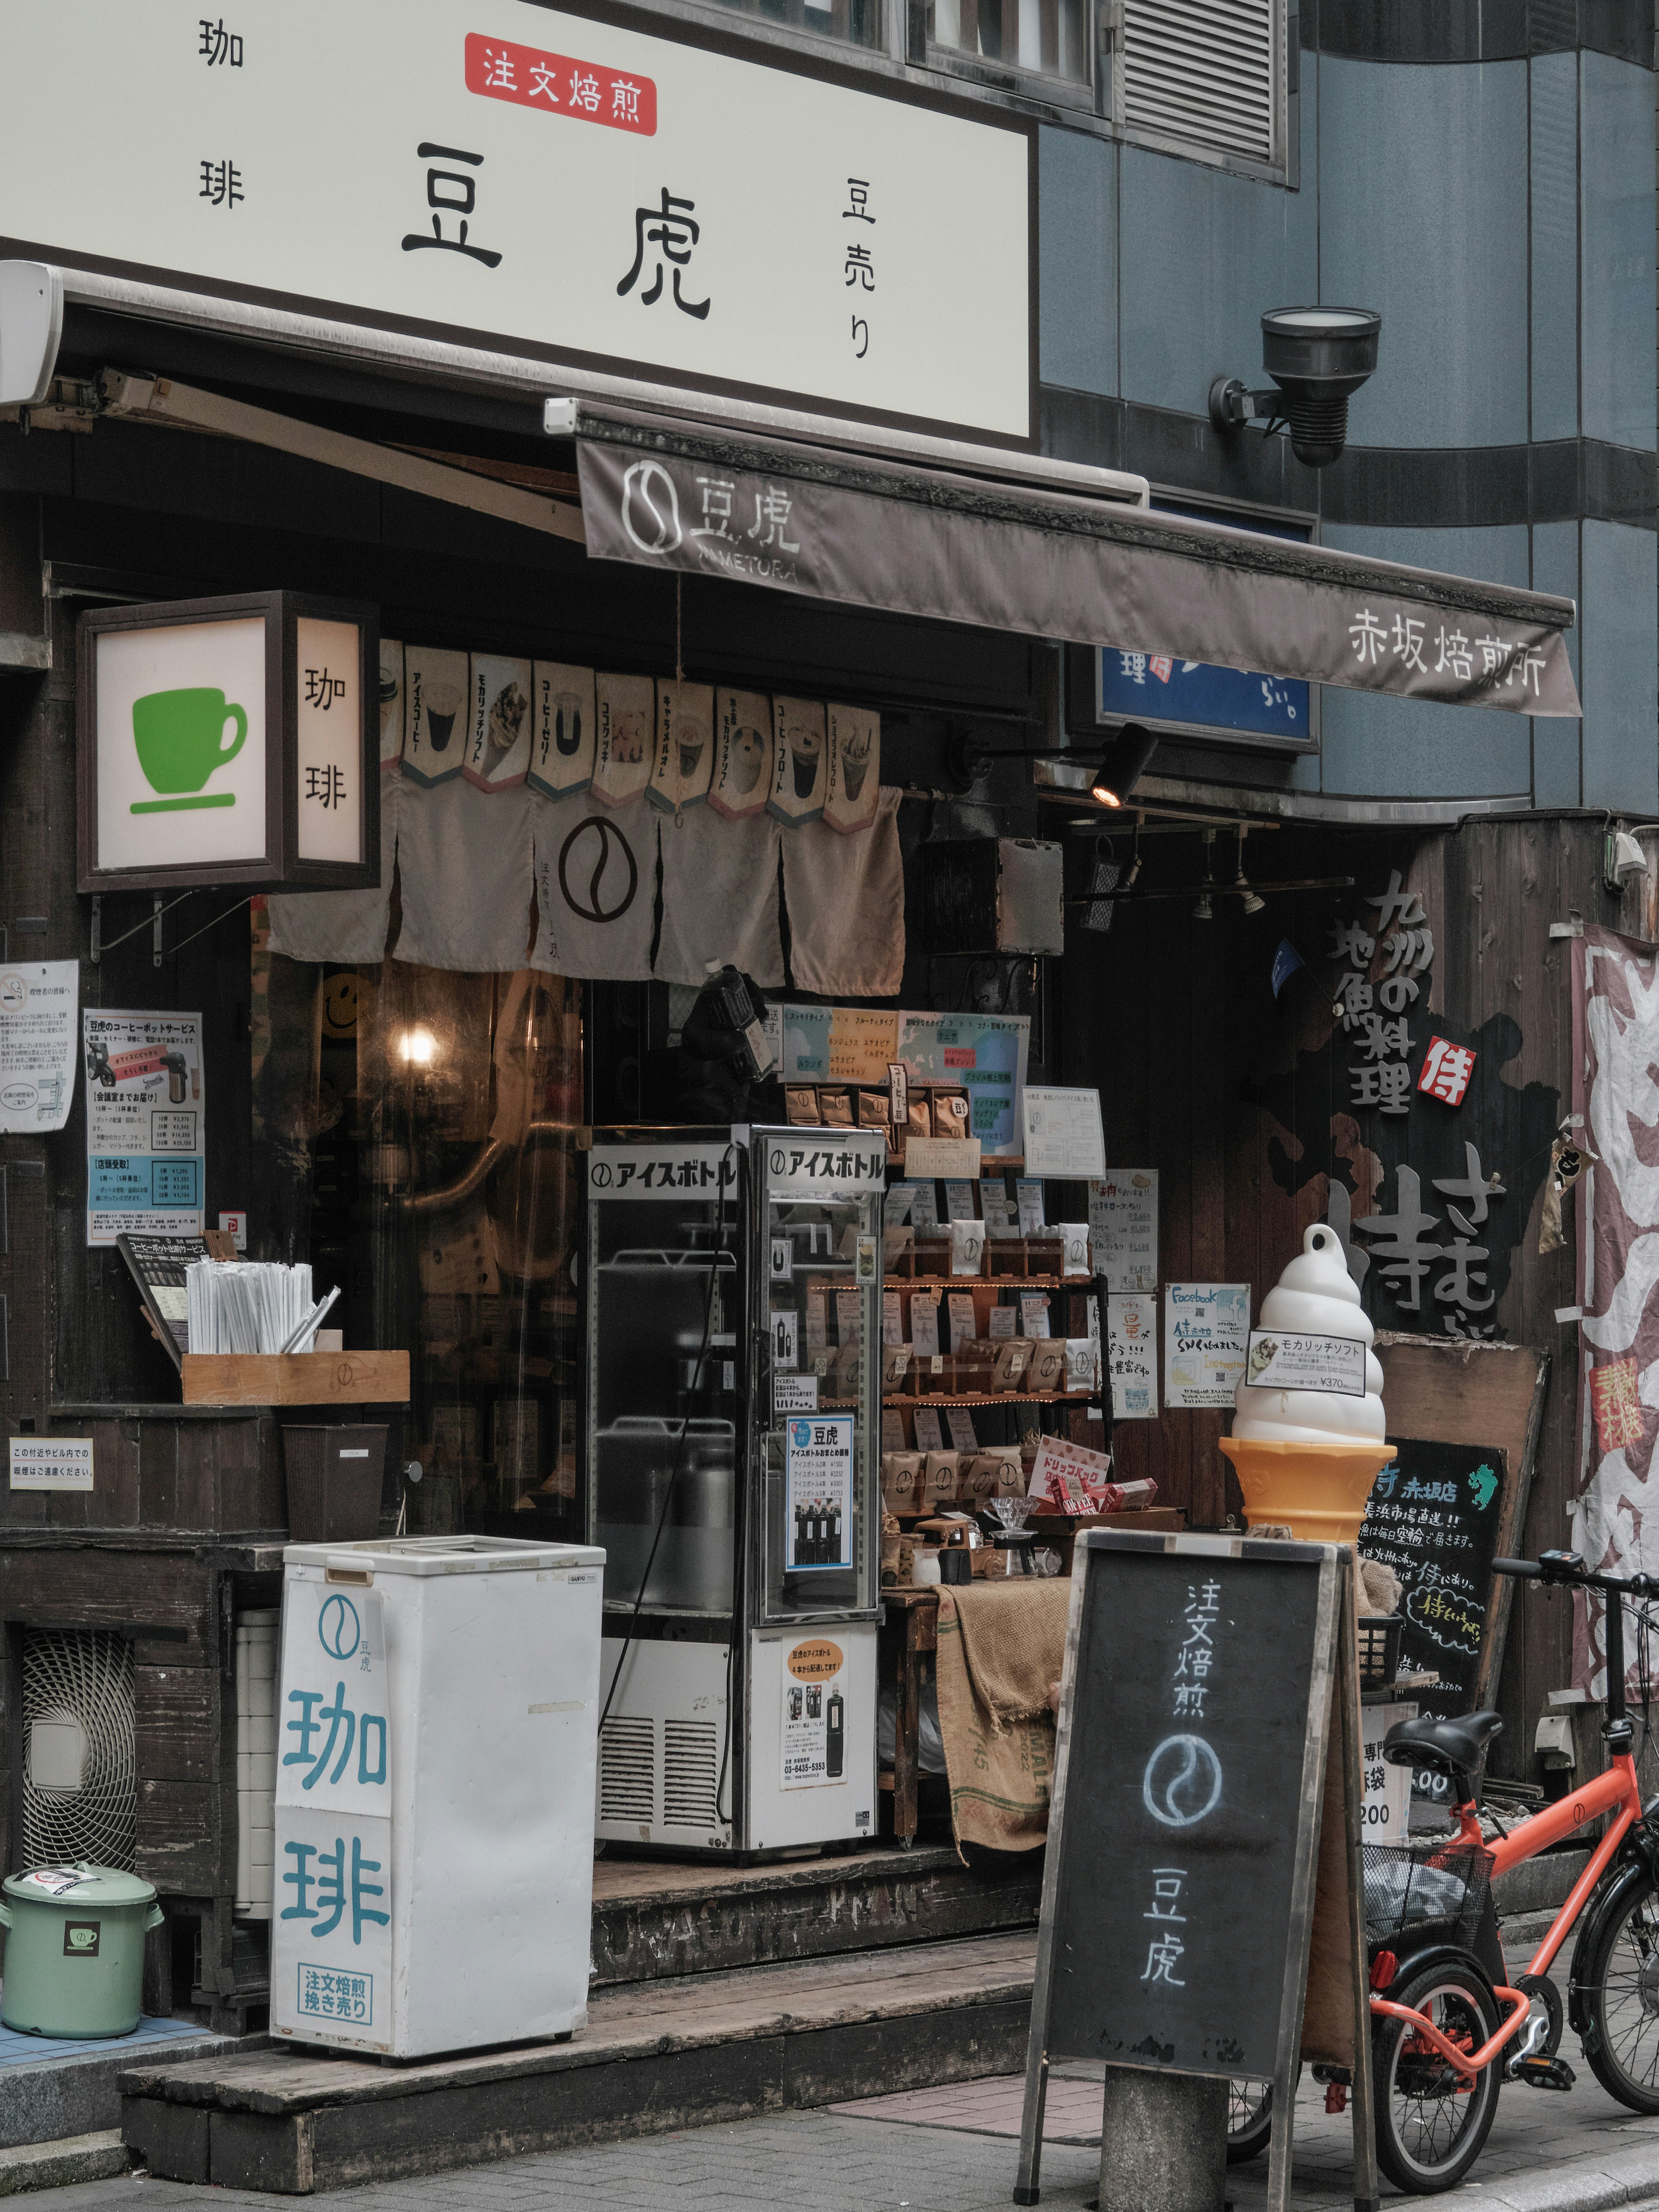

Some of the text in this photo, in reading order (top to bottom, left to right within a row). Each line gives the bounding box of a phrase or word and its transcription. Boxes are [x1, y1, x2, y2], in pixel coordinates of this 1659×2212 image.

[484, 48, 642, 124] 注文焙煎
[199, 18, 245, 209] 珈琲
[401, 142, 710, 320] 豆虎
[842, 178, 876, 358] 豆売り
[690, 476, 799, 553] 豆虎
[1349, 608, 1546, 696] 赤坂焙煎所
[541, 680, 550, 764] コーヒーゼリー
[305, 668, 346, 809] 珈琲
[776, 705, 786, 793] コーヒーフロート
[1364, 870, 1435, 1013] 九州の
[30, 987, 70, 996] 喫煙者の皆様へ
[1424, 1040, 1472, 1104] 侍
[893, 1068, 903, 1119] コーヒー豆
[616, 1160, 737, 1188] アイスボトル
[789, 1151, 883, 1179] アイスボトル
[1172, 1286, 1217, 1303] Facebook
[1282, 1340, 1359, 1356] モカリッチソフト
[1320, 1378, 1343, 1388] ¥370
[814, 1425, 838, 1445] 豆虎
[14, 1448, 88, 1458] この付近やビル内での
[14, 1467, 92, 1477] 喫煙はご遠慮ください。
[1044, 1457, 1099, 1483] ドリップバッグ
[1401, 1477, 1457, 1502] 赤坂店
[360, 1641, 371, 1673] 豆虎
[792, 1649, 830, 1659] 豆虎のアイスボトル
[1173, 1579, 1221, 1718] 注文焙煎
[785, 1762, 825, 1774] 03-6435-5353
[280, 1681, 390, 1945] 珈琲
[1139, 1869, 1187, 1986] 豆虎
[306, 1970, 365, 1998] 注文焙煎
[305, 1990, 365, 2018] 挽き売り
